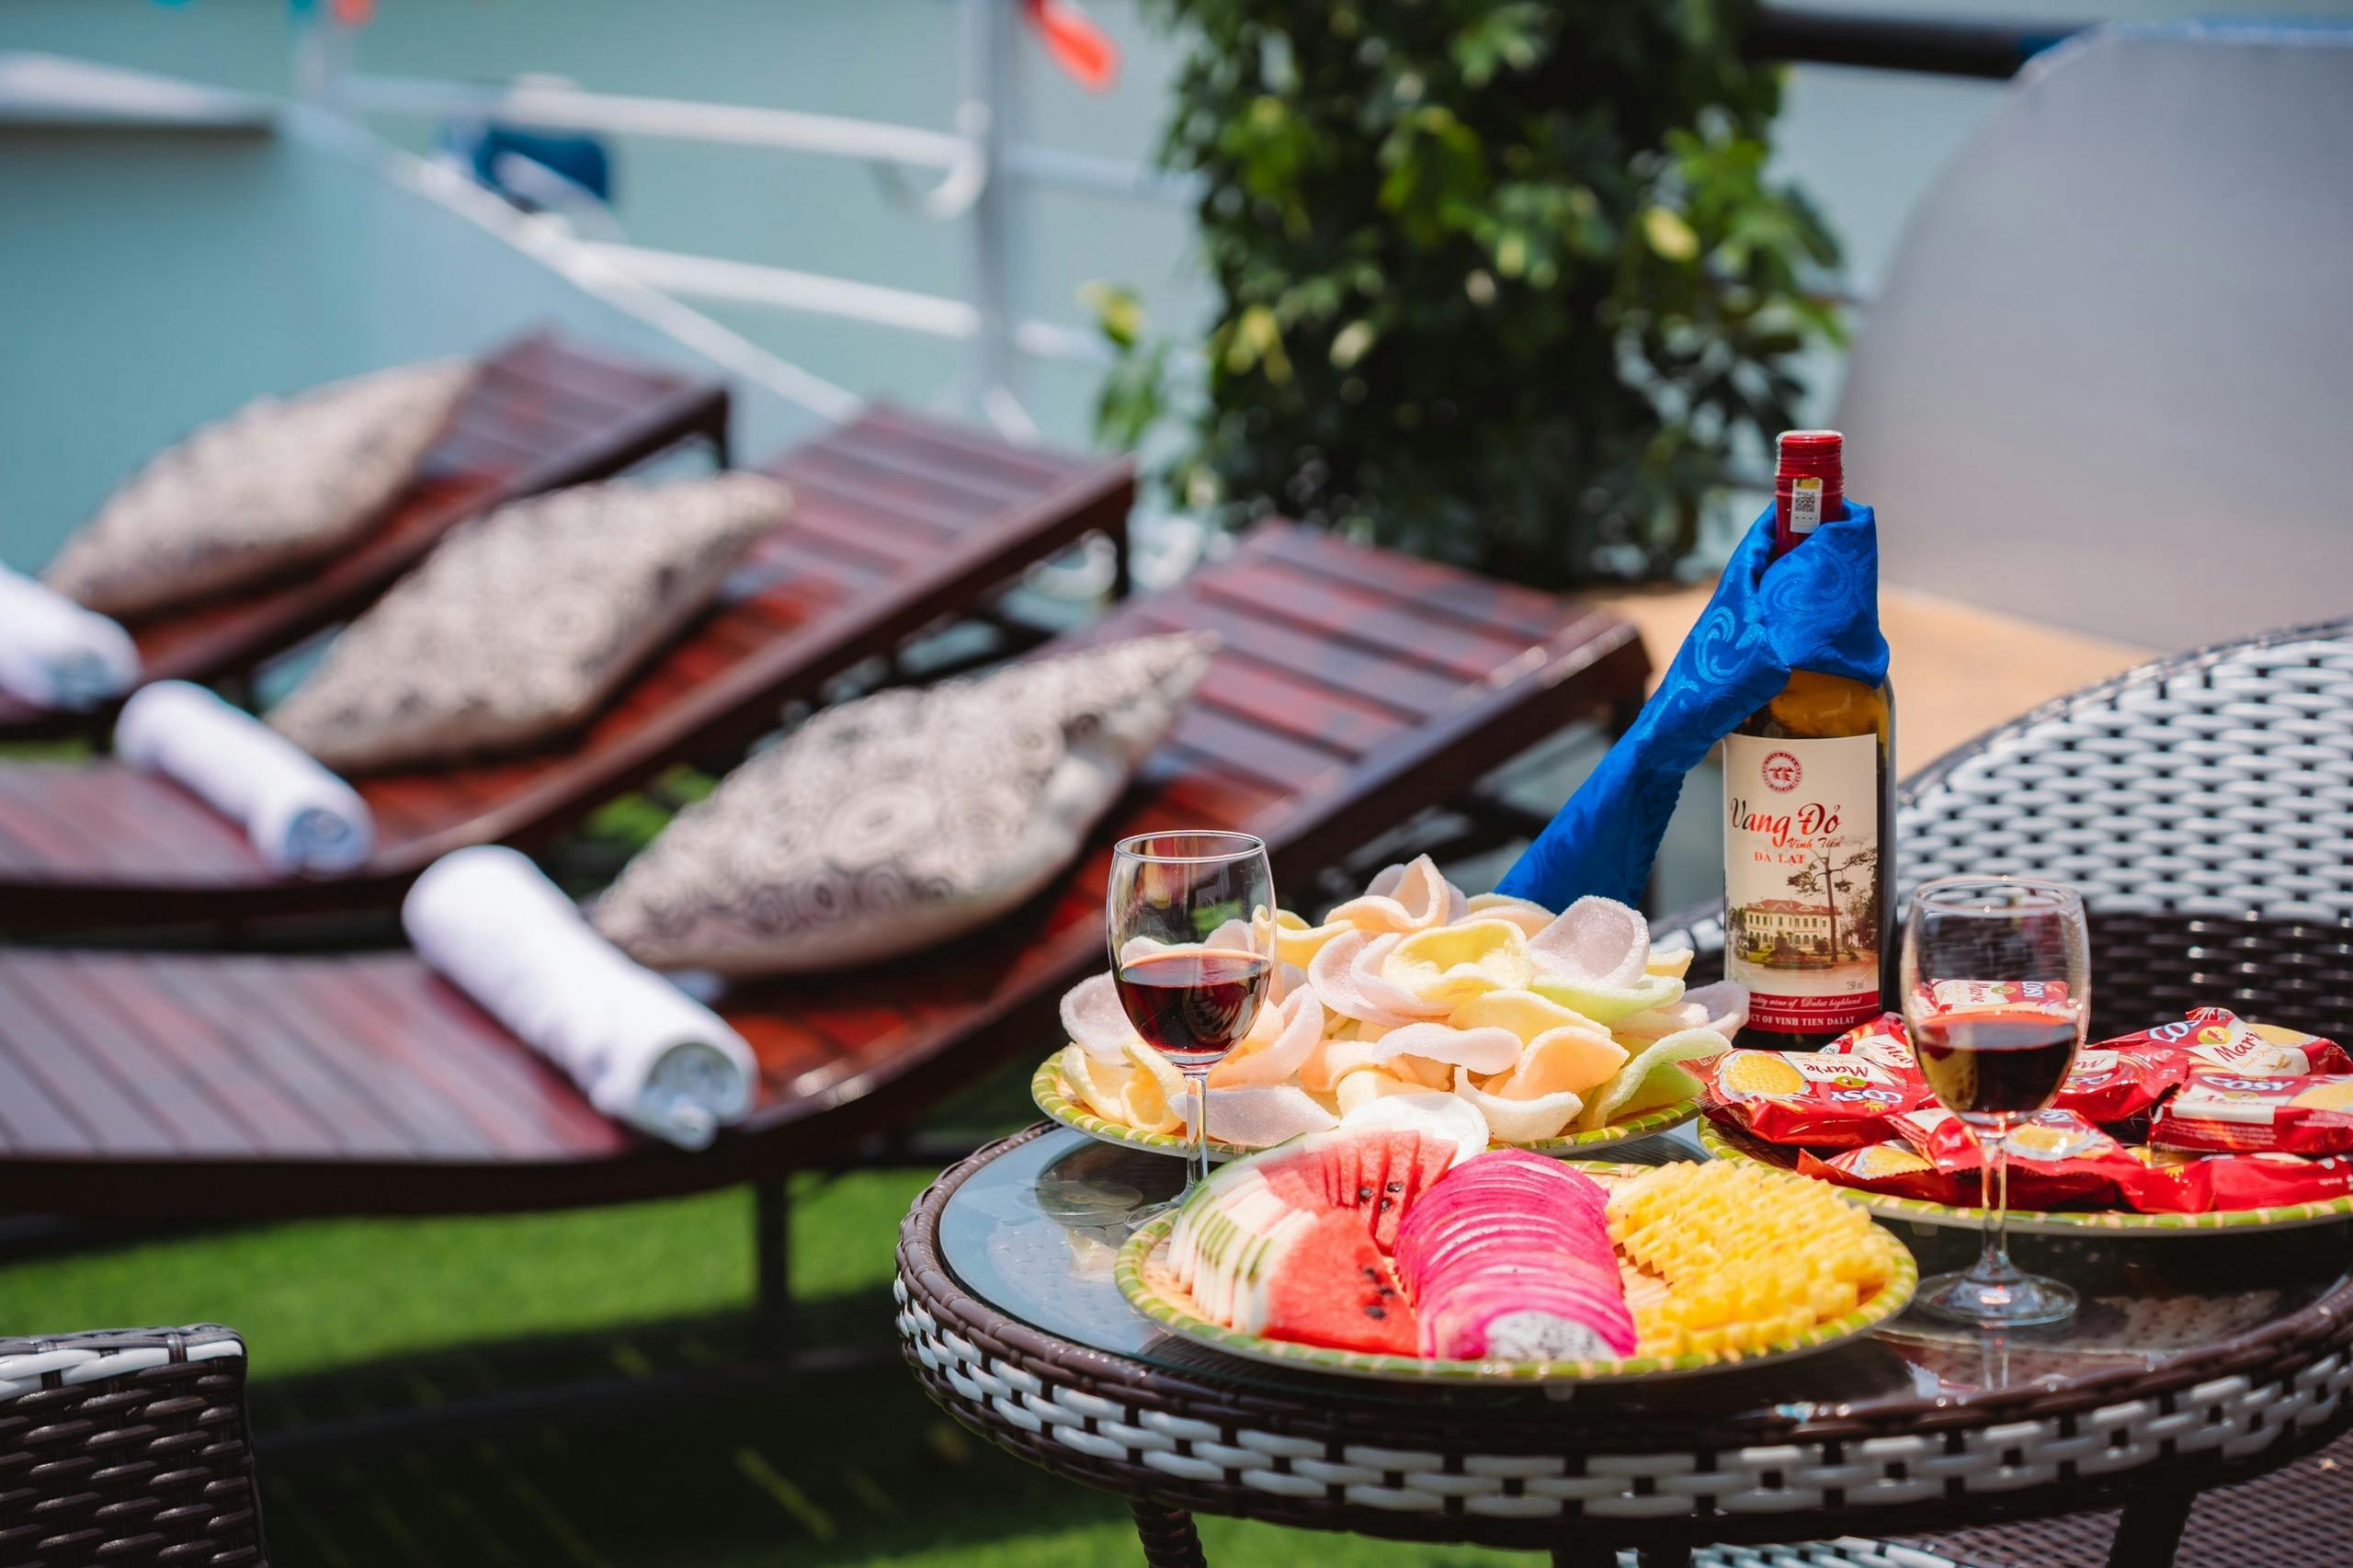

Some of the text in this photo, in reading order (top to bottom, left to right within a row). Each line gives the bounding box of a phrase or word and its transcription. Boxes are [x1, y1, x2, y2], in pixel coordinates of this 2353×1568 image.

[1730, 797, 1841, 847] Vang Đỏ
[1788, 998, 1799, 1009] of
[1801, 997, 1827, 1007] Dalat
[1828, 996, 1862, 1009] highland
[1762, 1015, 1772, 1024] OF
[1775, 1016, 1799, 1026] VINH
[1802, 1017, 1824, 1027] TIEN
[1827, 1016, 1855, 1027] DALAT
[2214, 1030, 2263, 1062] Mari
